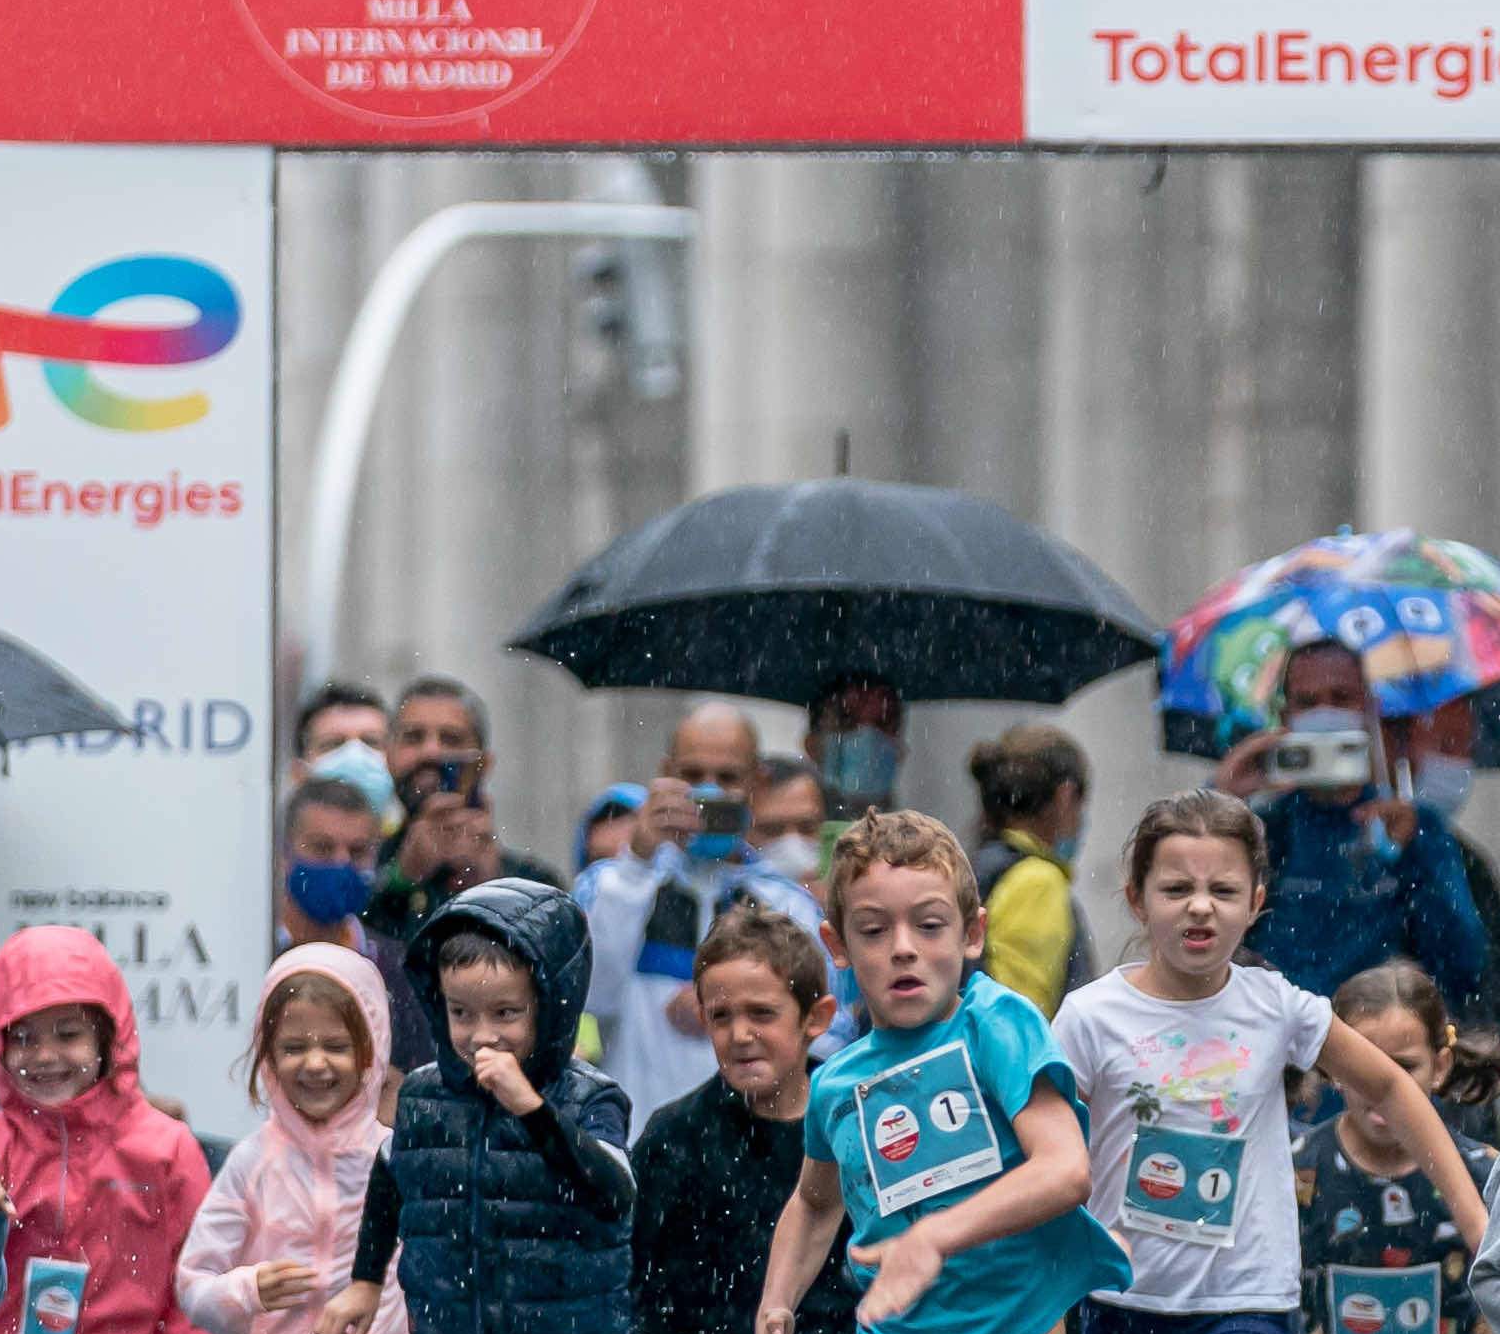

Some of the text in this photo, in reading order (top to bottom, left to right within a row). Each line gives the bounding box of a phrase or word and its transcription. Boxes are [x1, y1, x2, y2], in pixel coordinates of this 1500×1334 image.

[325, 60, 513, 91] DE MADRID
[940, 1097, 957, 1125] 1
[1210, 1173, 1220, 1197] 1
